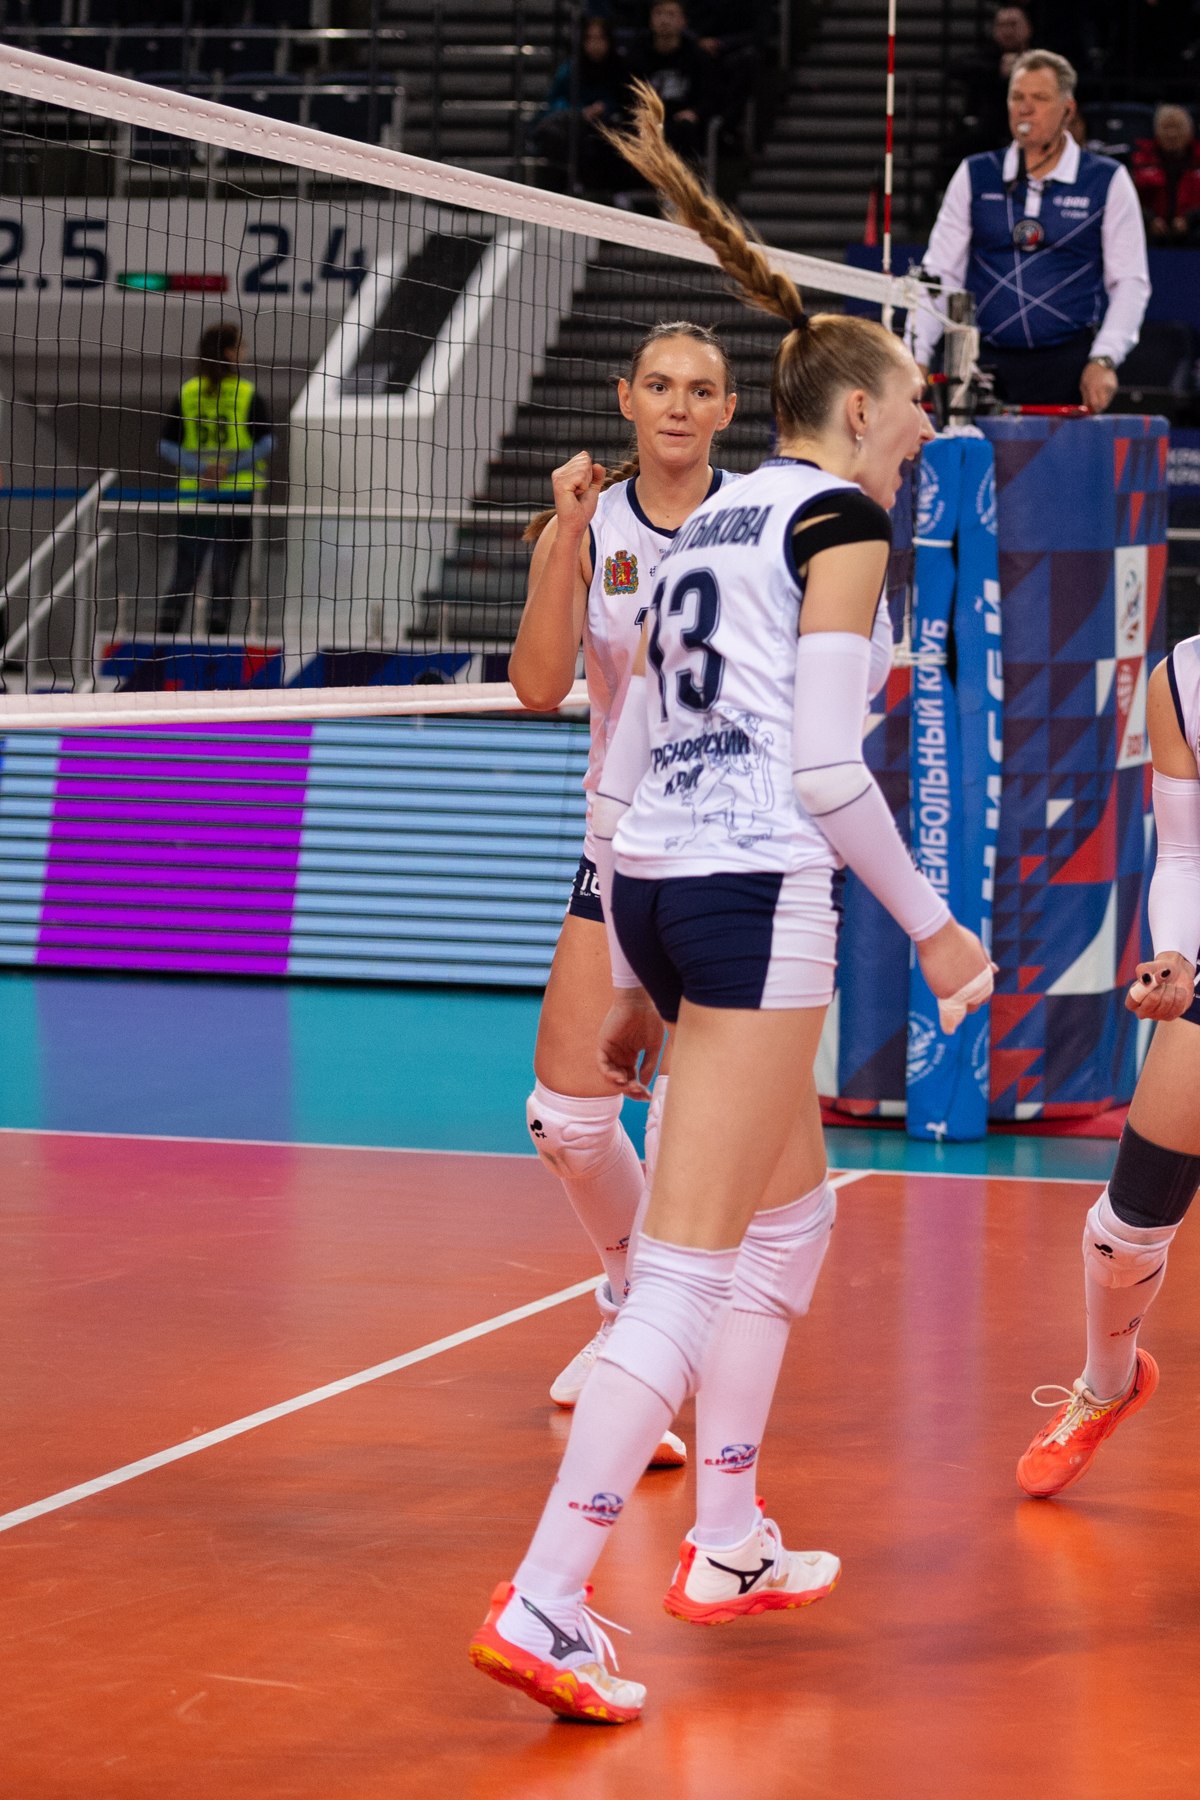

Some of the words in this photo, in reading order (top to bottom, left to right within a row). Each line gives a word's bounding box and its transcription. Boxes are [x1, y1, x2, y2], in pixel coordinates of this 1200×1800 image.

[242, 221, 367, 295] 2.4
[649, 566, 725, 722] 13
[917, 618, 948, 692] КЛУБ
